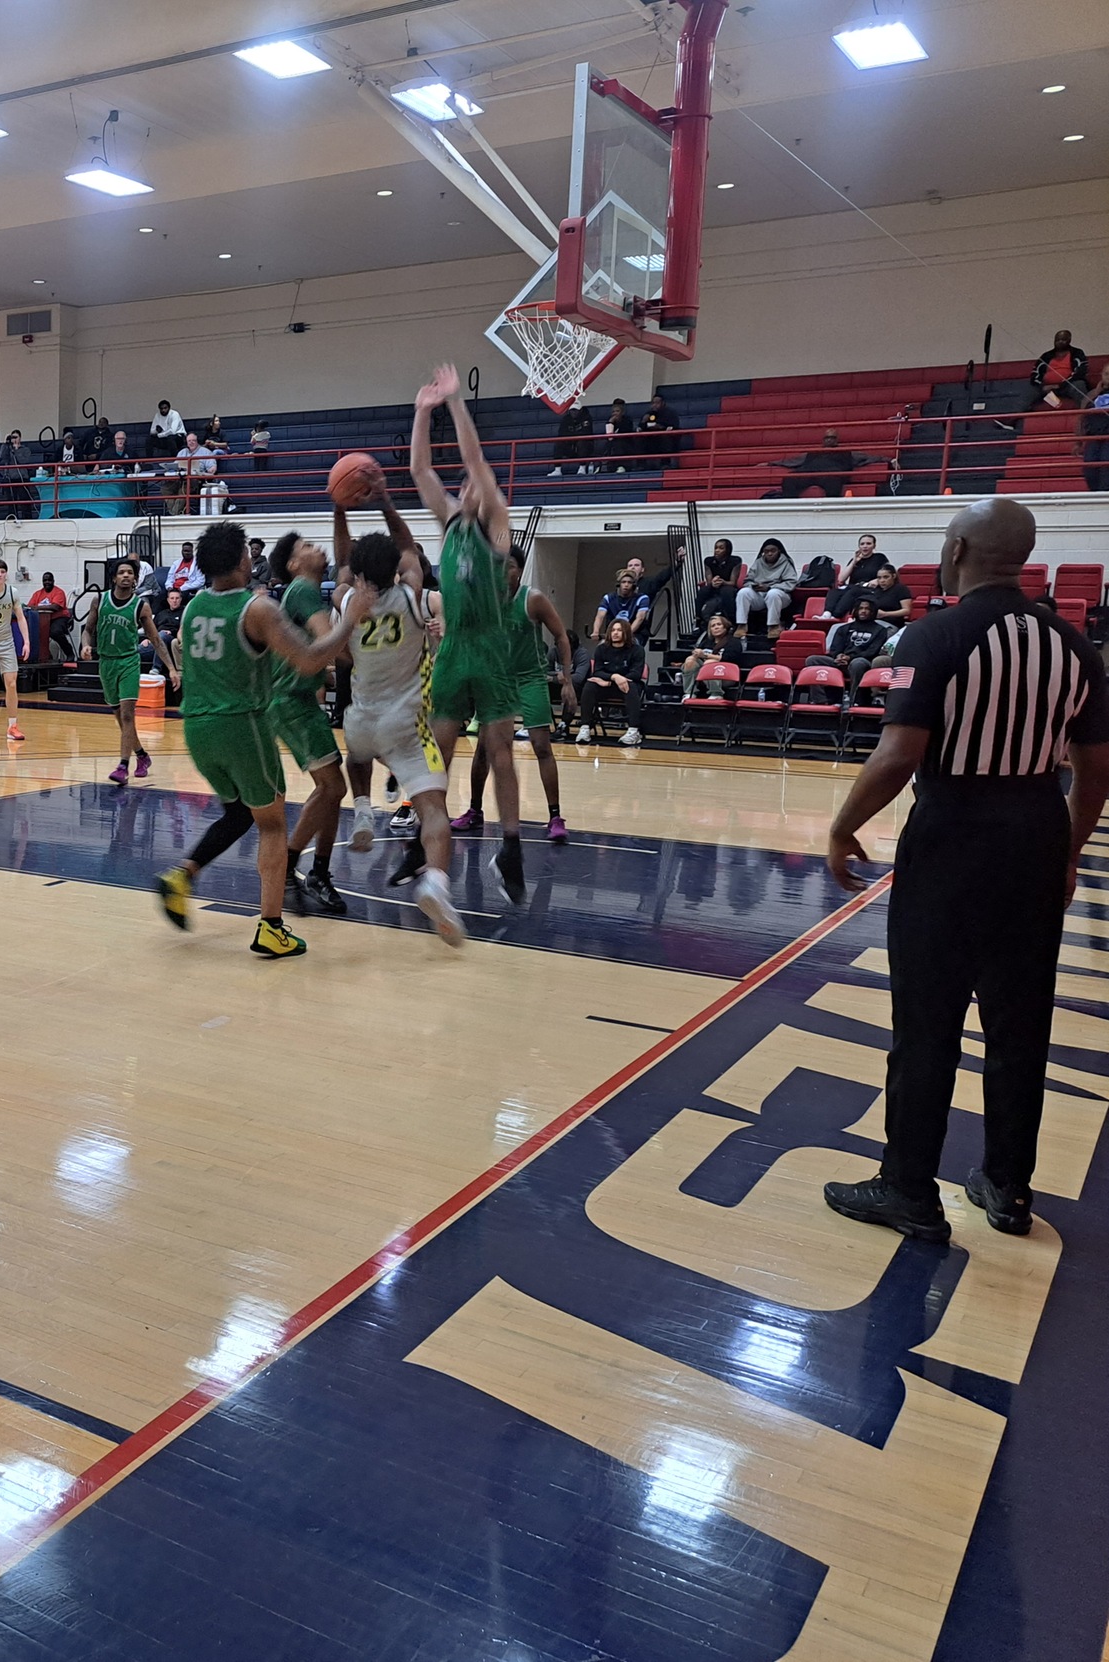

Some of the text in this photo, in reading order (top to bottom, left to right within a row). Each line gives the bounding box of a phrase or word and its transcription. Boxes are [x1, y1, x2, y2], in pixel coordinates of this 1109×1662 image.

[110, 628, 117, 645] 1
[189, 615, 227, 661] 35
[359, 611, 404, 652] 23
